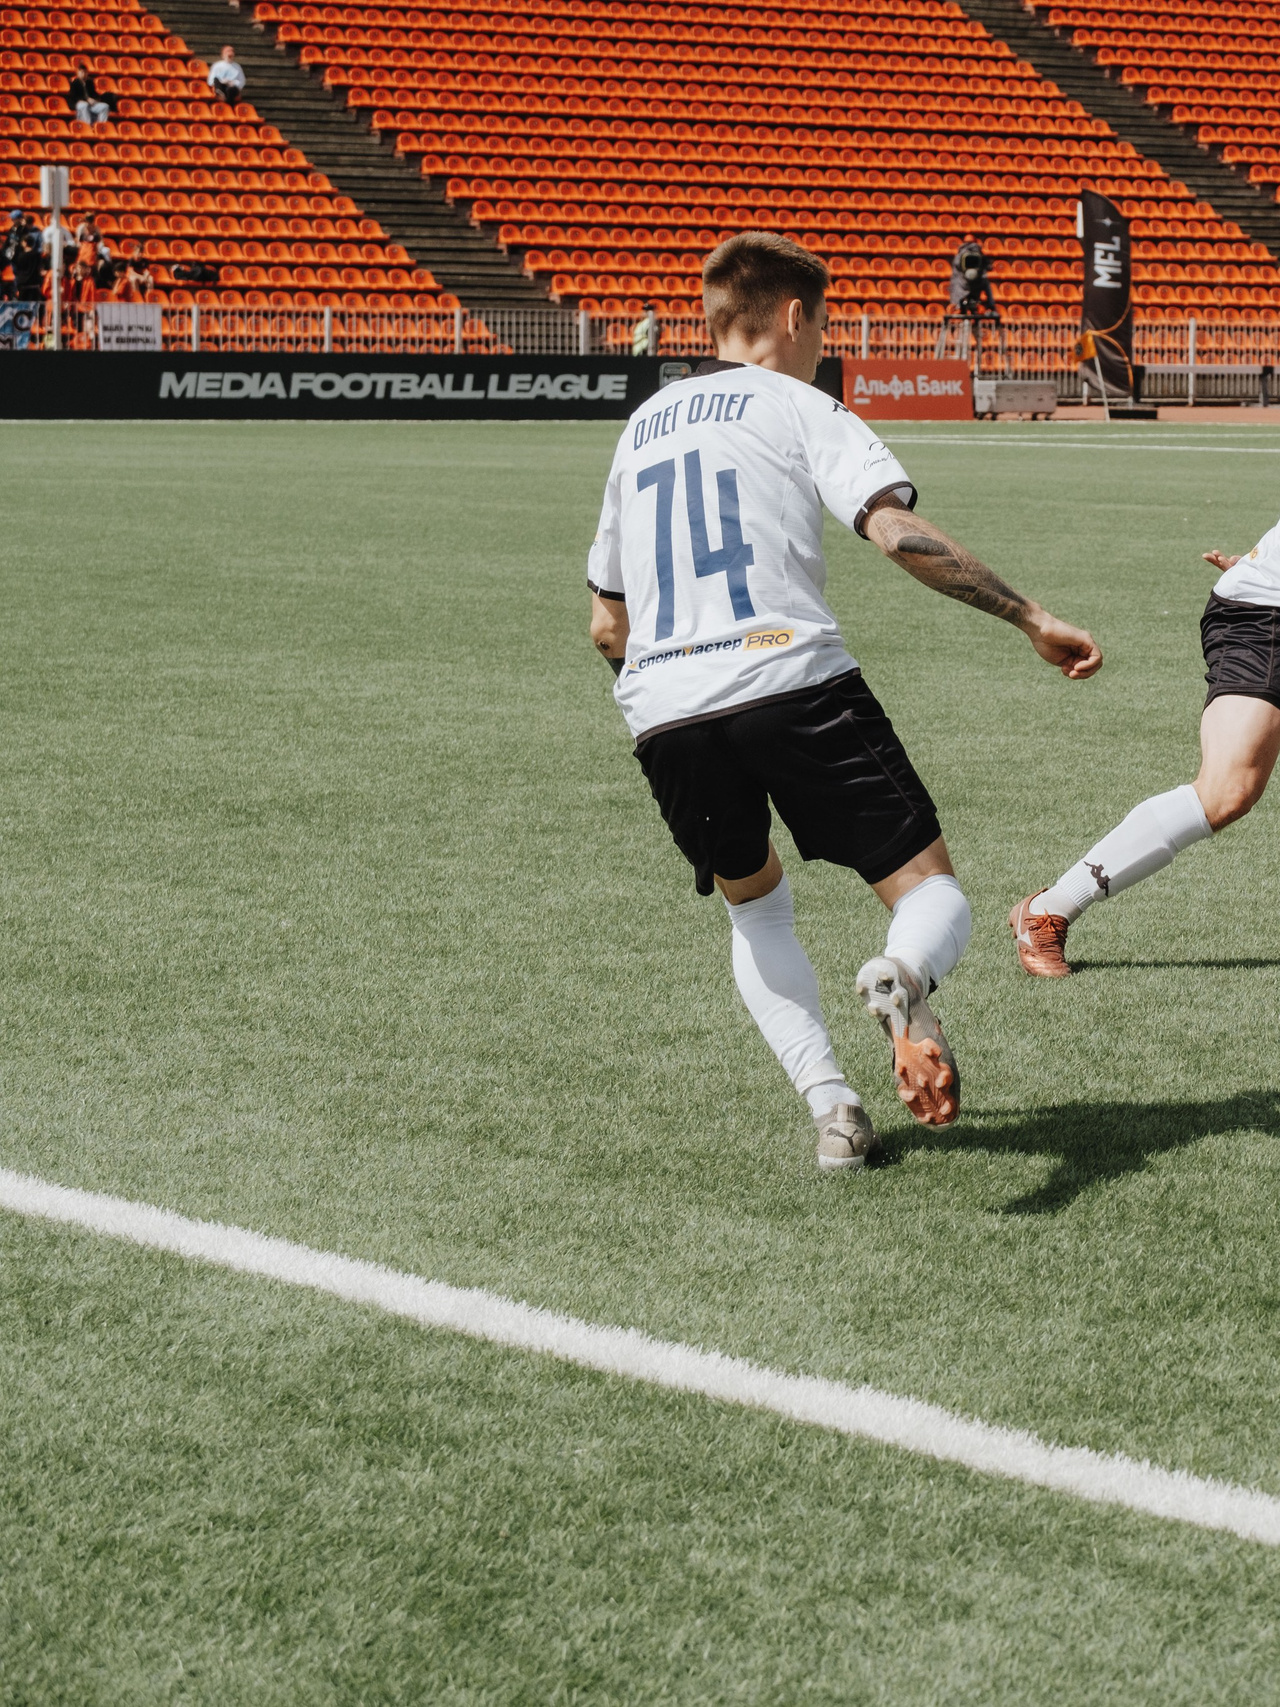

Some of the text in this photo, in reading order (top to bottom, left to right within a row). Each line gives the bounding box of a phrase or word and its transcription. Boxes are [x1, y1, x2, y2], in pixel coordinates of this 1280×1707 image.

[1093, 236, 1121, 289] MFL
[158, 372, 287, 399] MEDIA
[289, 373, 486, 400] FOOTBALL
[486, 373, 628, 401] LEAGUE
[854, 374, 964, 405] Альфа Банк
[634, 392, 754, 451] ОЛЕГ ОЛЕГ
[637, 449, 755, 642] 74
[746, 632, 790, 650] PRO
